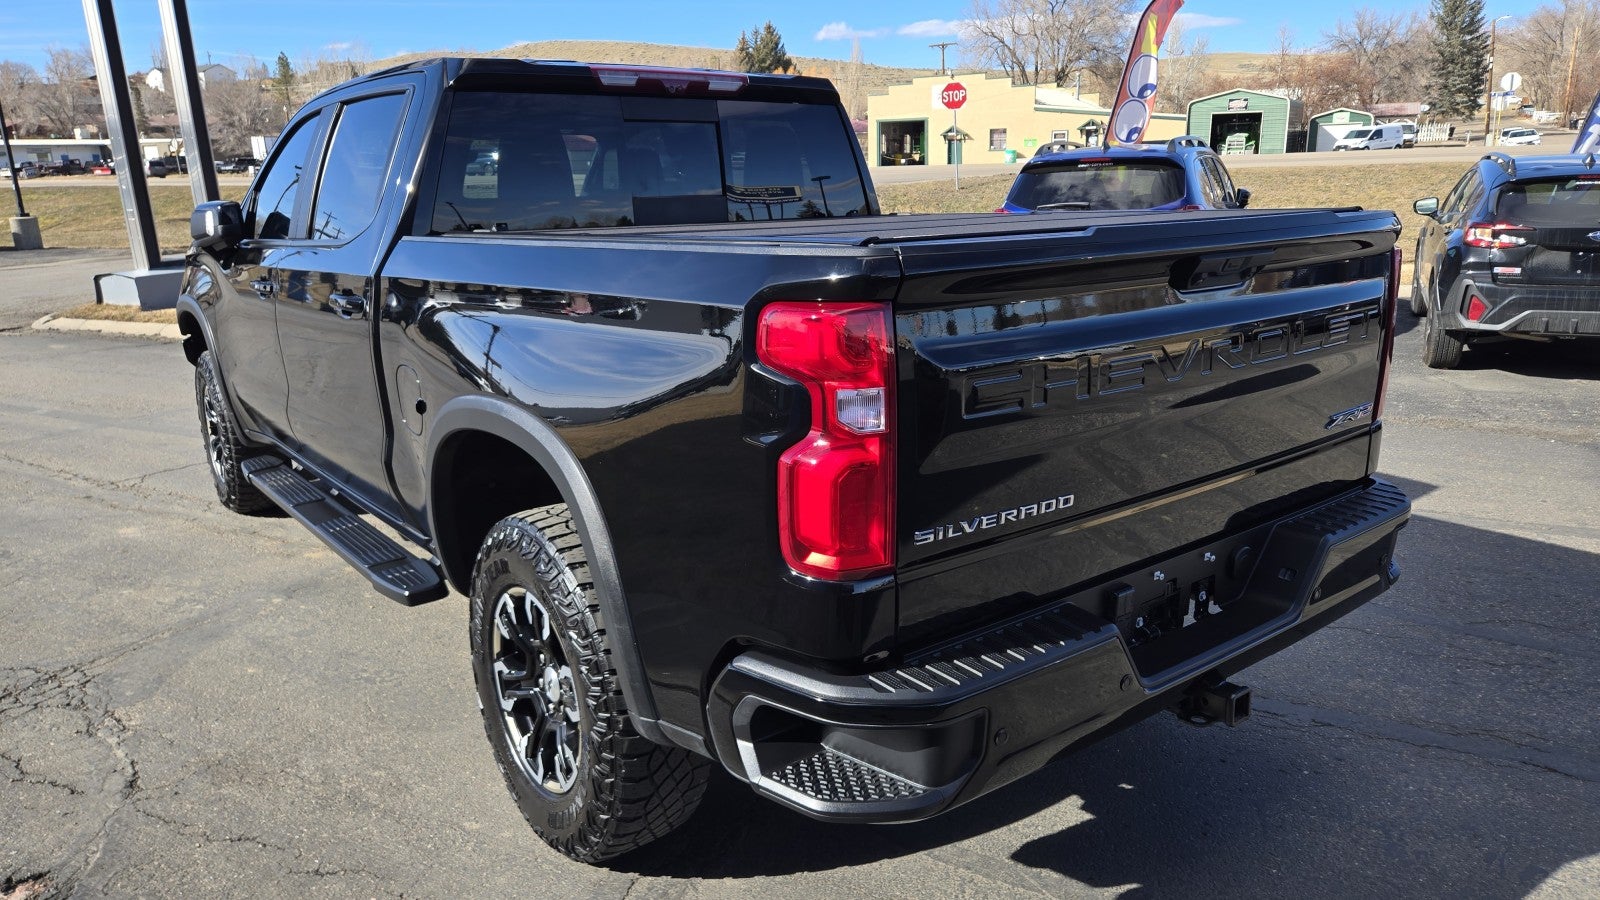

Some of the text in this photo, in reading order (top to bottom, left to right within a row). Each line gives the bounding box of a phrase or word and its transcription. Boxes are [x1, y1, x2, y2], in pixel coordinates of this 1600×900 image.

[942, 89, 966, 103] STOP
[962, 304, 1379, 420] CHEVROLET
[914, 494, 1075, 546] SILVERADO
